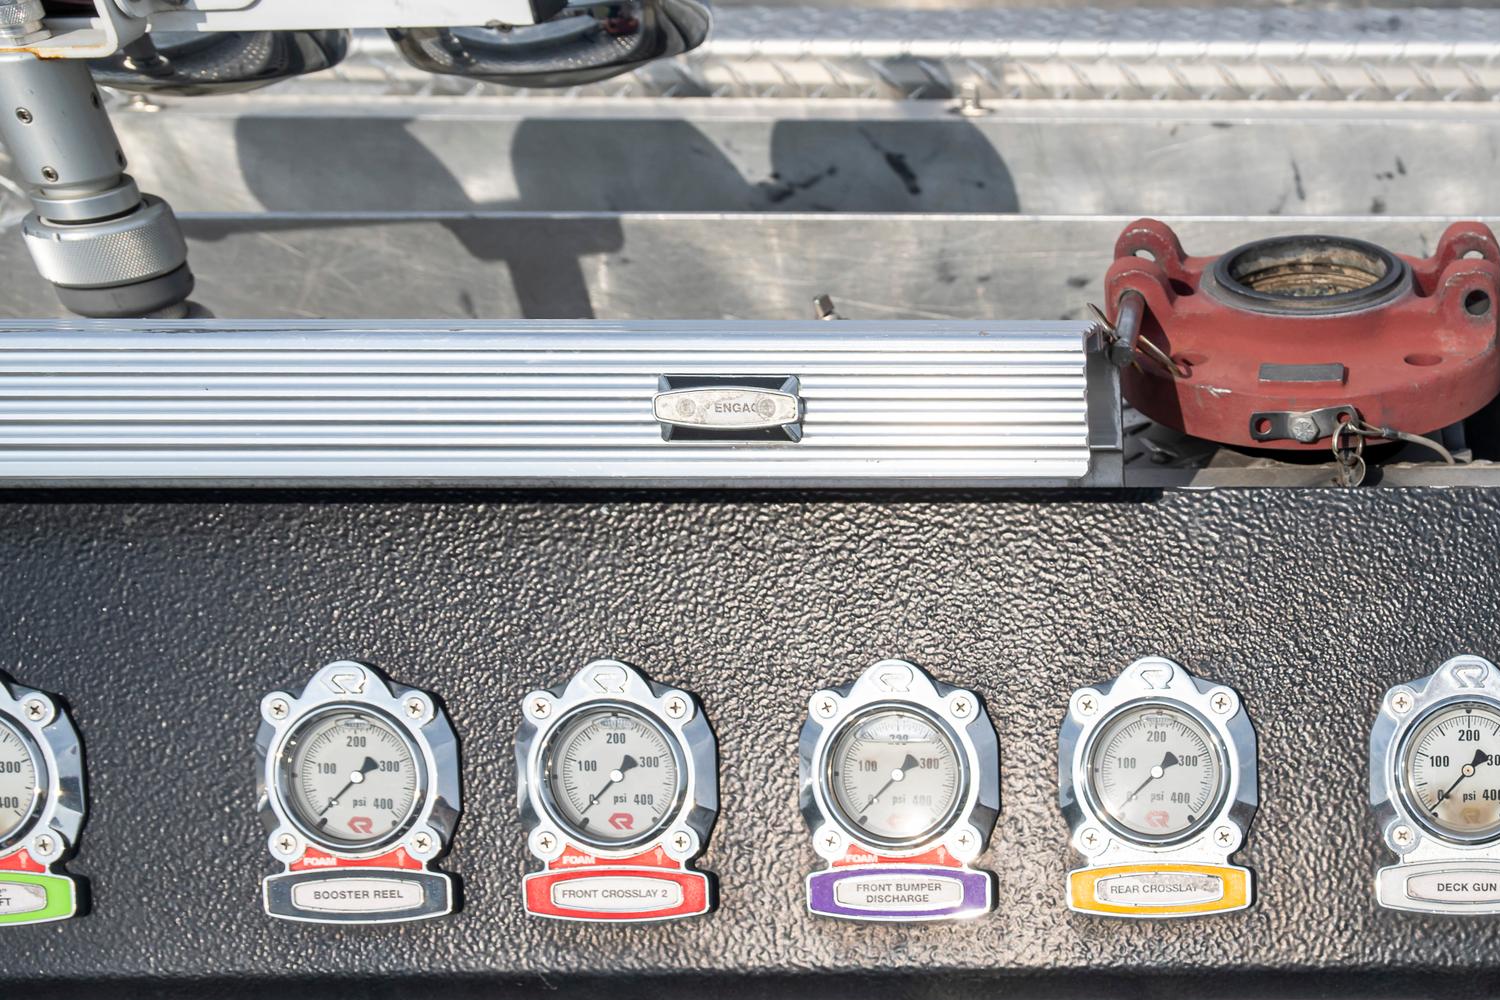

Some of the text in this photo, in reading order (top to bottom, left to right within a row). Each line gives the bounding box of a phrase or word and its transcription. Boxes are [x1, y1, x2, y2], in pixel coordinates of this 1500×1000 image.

[1458, 730, 1480, 741] 200
[1430, 756, 1449, 767] 100
[1463, 791, 1476, 801] psi
[896, 883, 941, 891] BUMPER
[1111, 885, 1139, 894] REAR
[1437, 883, 1497, 892] DECK GUN
[314, 890, 403, 899] BOOSTER REEL
[562, 890, 598, 898] FRONT
[602, 890, 658, 898] CROSSLAY
[866, 895, 929, 903] DISCHARGE
